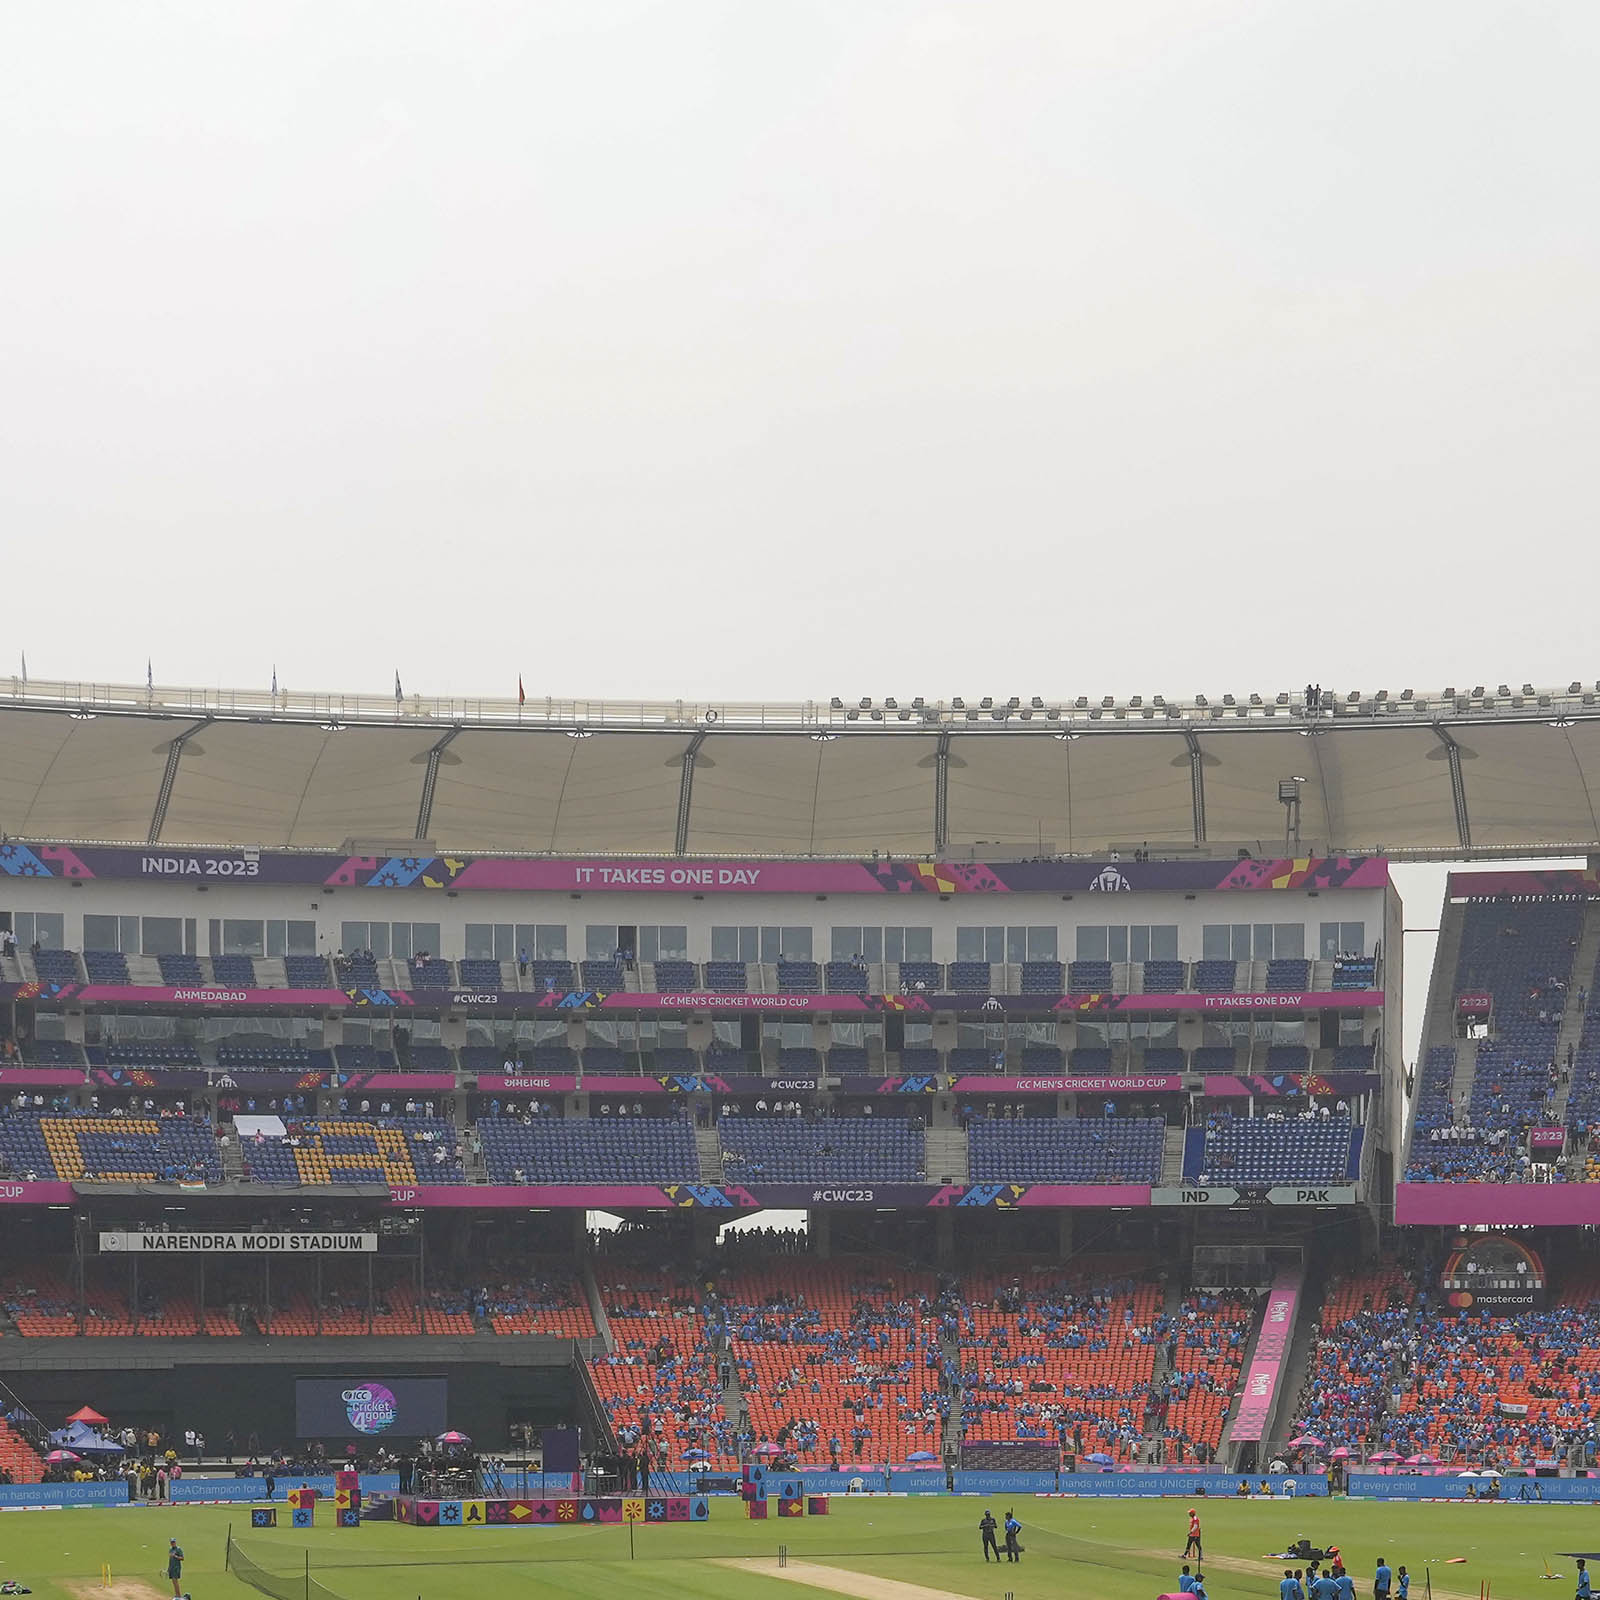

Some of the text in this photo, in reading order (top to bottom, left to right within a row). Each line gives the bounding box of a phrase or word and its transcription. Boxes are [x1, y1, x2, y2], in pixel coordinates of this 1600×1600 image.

[142, 857, 259, 875] INDIA 2023
[576, 868, 760, 884] IT TAKES ONE DAY
[174, 991, 247, 1001] AHMEDABAD
[453, 994, 498, 1003] #CWC23
[660, 996, 809, 1007] ICC MEN'S CRICKET WORLD CUP
[1205, 996, 1301, 1006] IT TAKES ONE DAY
[770, 1080, 815, 1089] #CWC23
[1016, 1078, 1167, 1089] ICC MEN'S CRICKET WORLD CUP
[812, 1190, 873, 1202] #CWC23
[1181, 1190, 1329, 1202] IND PAK
[143, 1235, 363, 1249] NARENDRA MODI STADIUM
[1476, 1295, 1533, 1304] mastercard
[353, 1391, 368, 1400] ICC
[352, 1401, 390, 1412] Cricket
[366, 1409, 393, 1422] good
